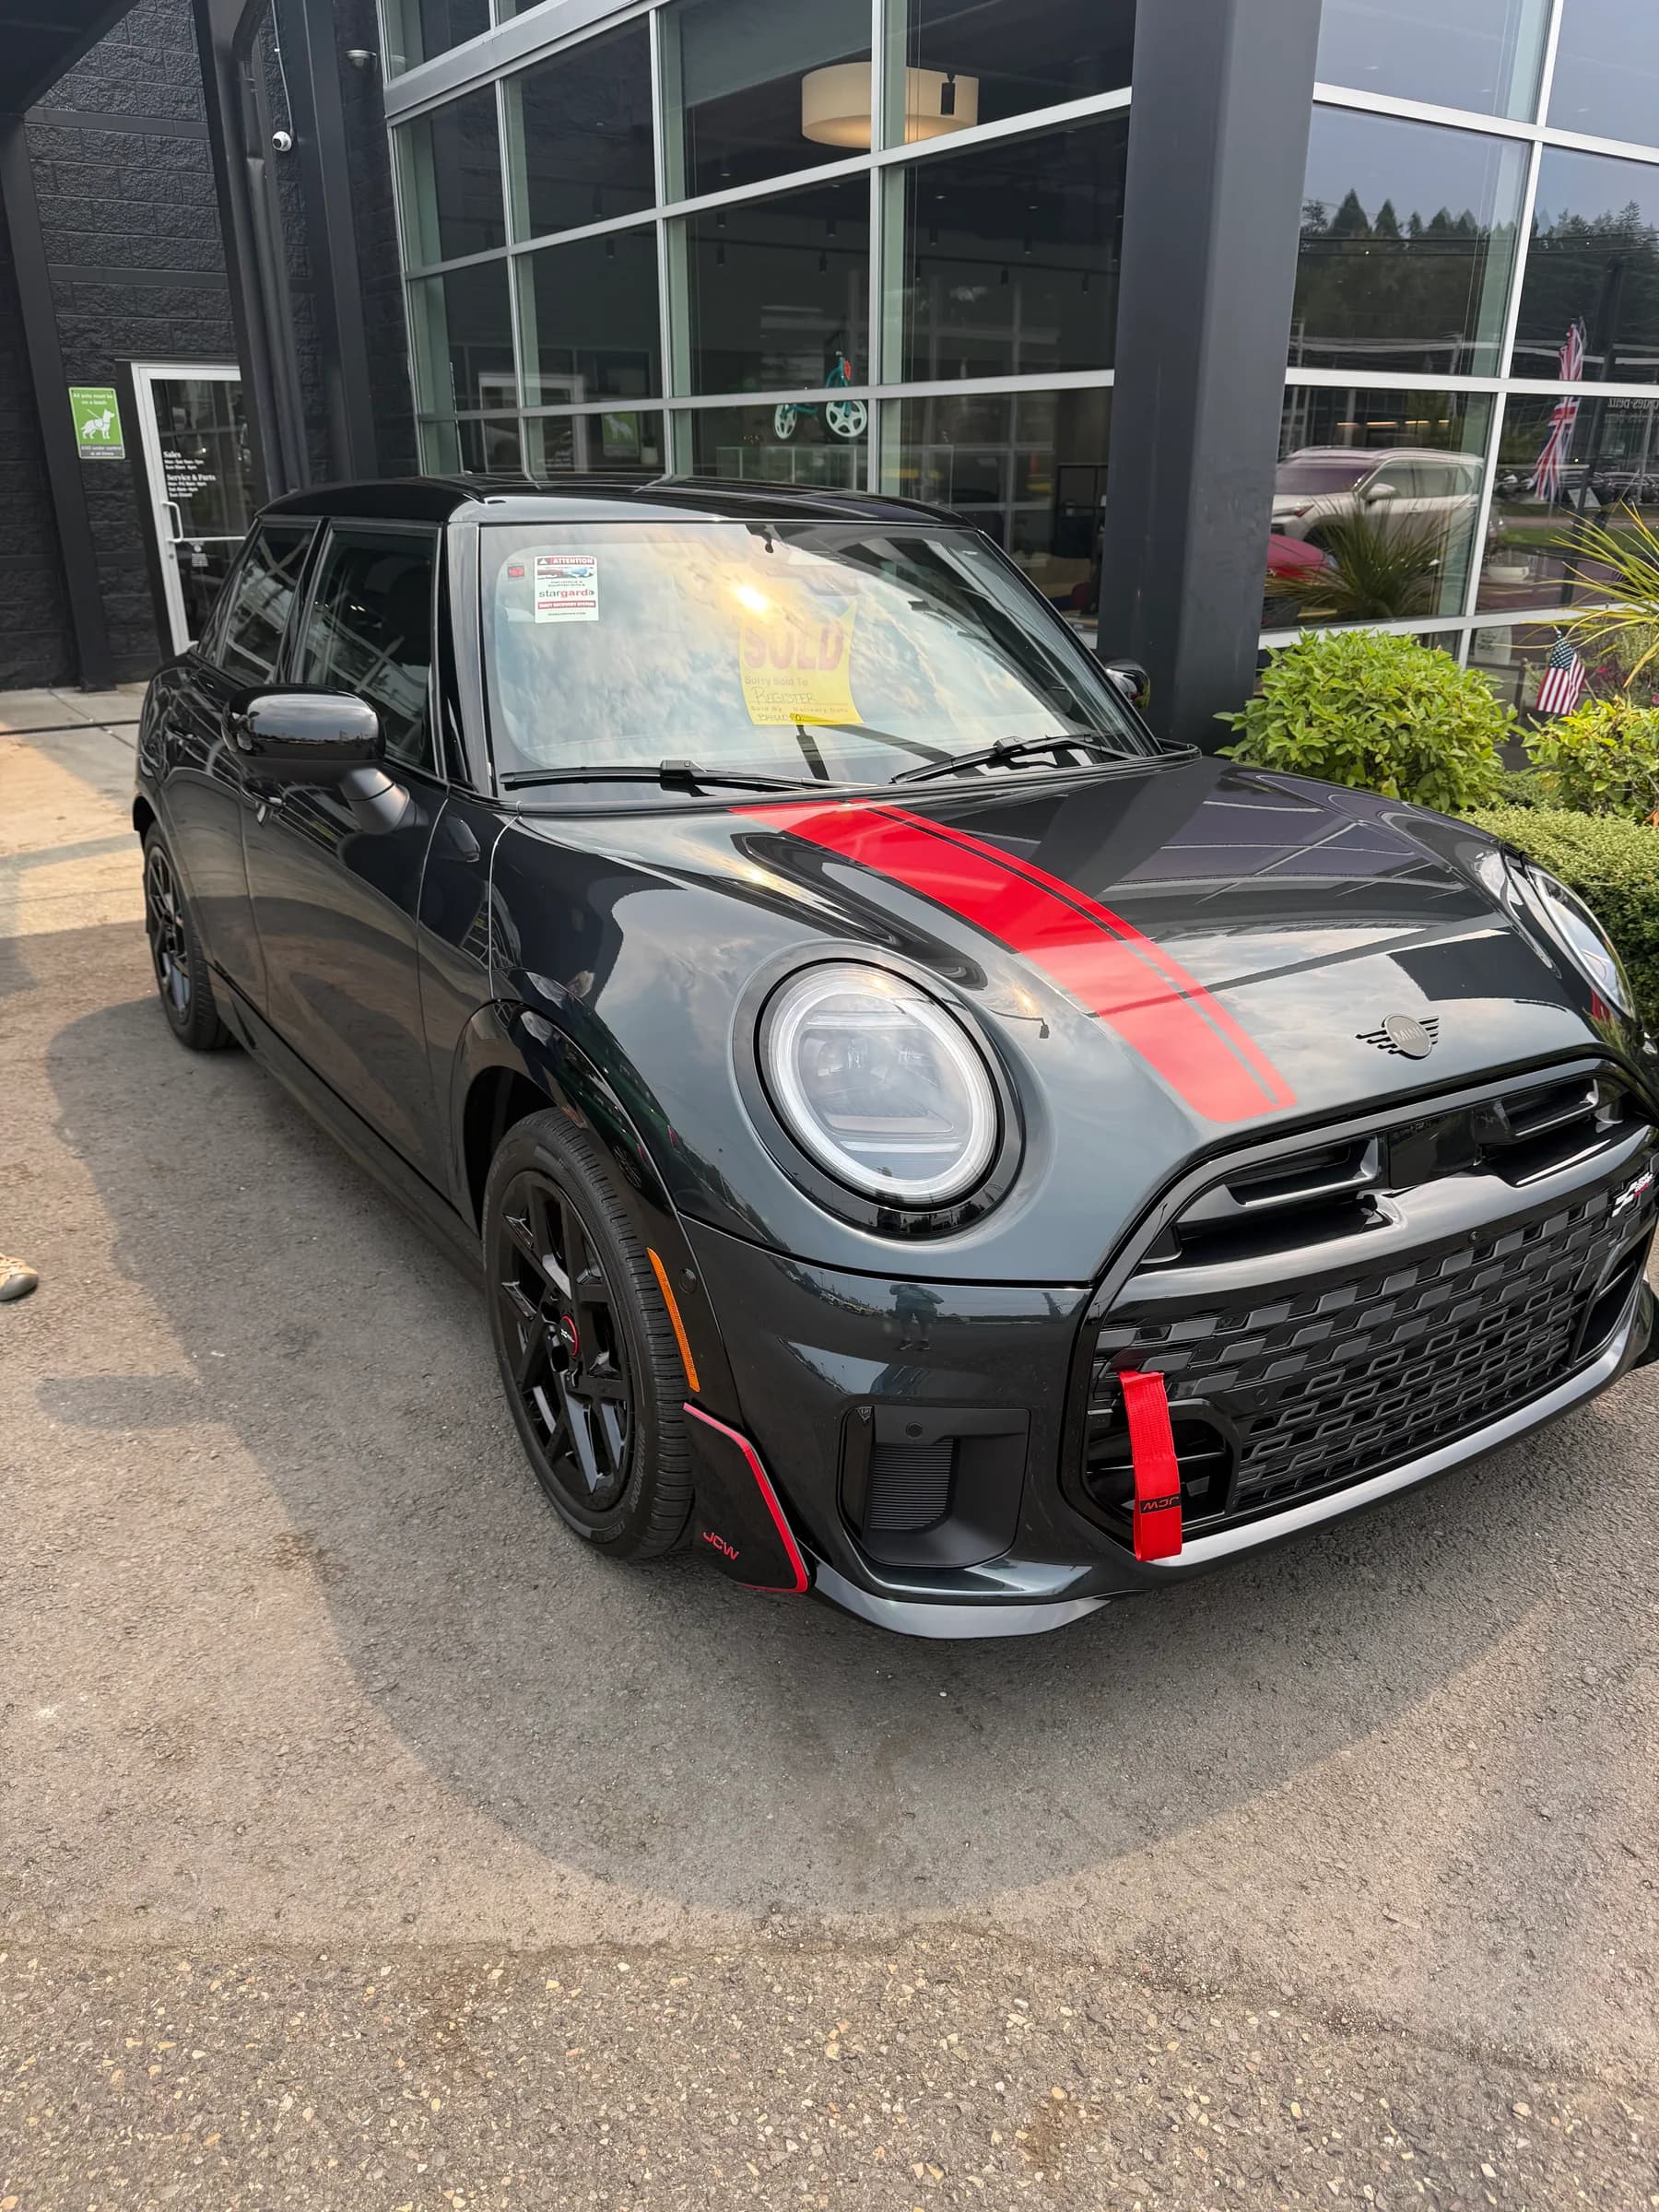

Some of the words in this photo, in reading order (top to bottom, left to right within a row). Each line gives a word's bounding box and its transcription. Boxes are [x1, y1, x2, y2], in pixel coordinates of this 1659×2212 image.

[553, 557, 594, 565] ATTENTION
[744, 624, 844, 671] SOLD
[1143, 1496, 1180, 1512] JCW
[702, 1532, 739, 1560] JCW
